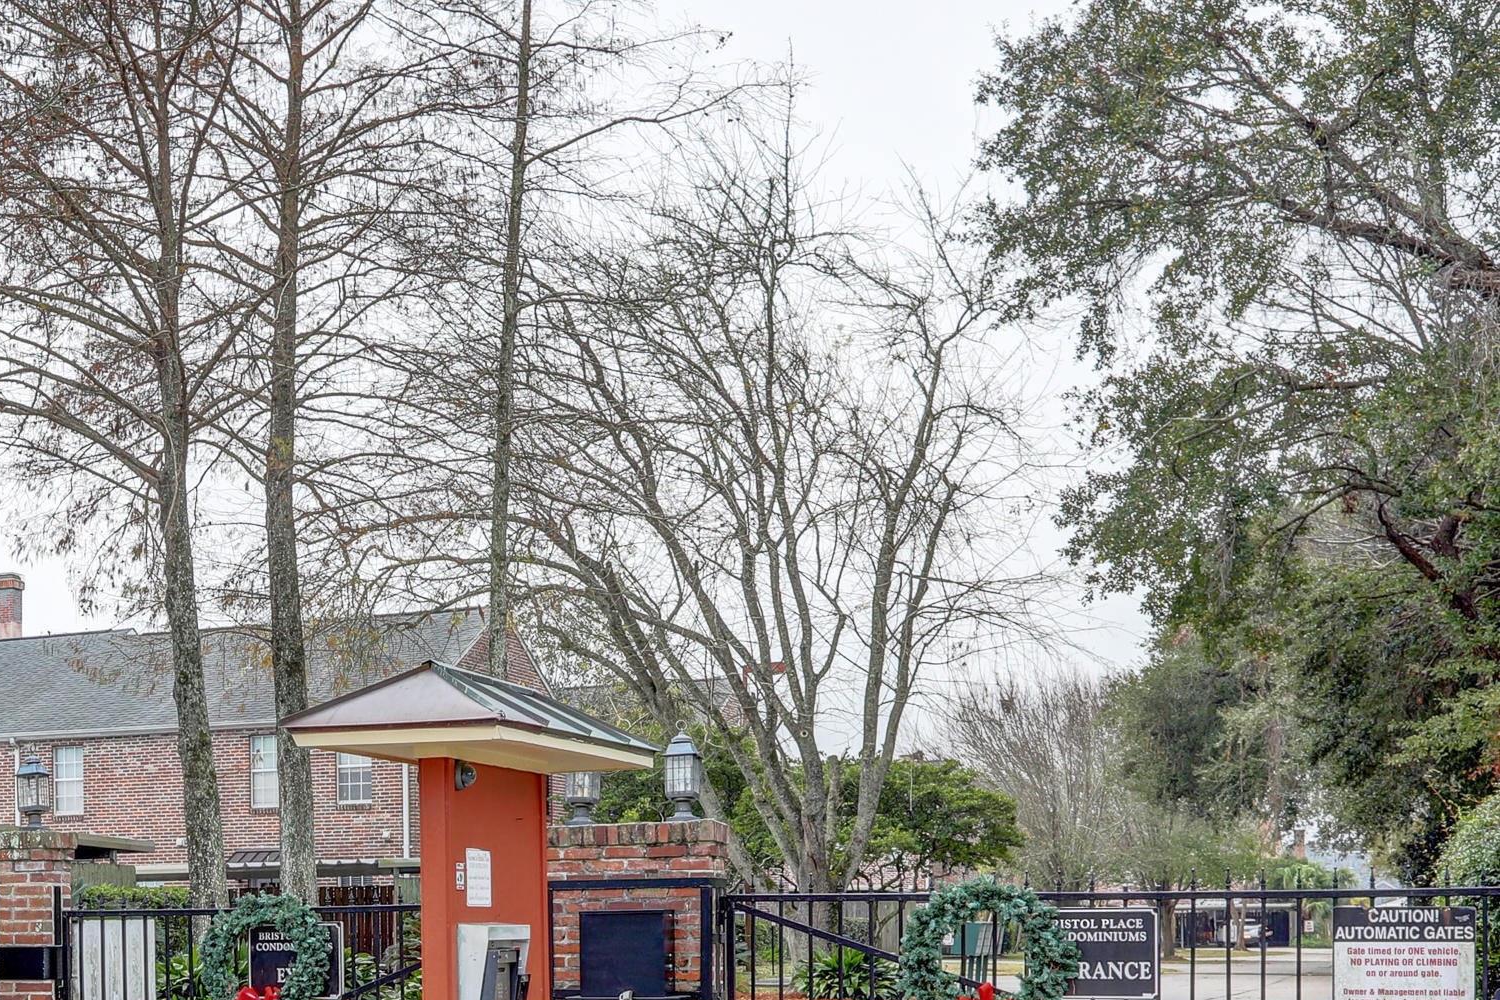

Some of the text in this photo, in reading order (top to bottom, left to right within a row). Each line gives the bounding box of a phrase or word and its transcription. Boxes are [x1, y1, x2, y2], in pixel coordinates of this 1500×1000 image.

[1368, 909, 1439, 923] CAUTION!
[1052, 918, 1144, 929] RISTOL PLACE
[1068, 931, 1147, 942] DOMINIUMS
[1335, 926, 1474, 940] AUTOMATIC GATES
[1347, 947, 1365, 955] Gate
[1368, 947, 1391, 955] timed
[1394, 947, 1406, 955] for
[1408, 947, 1425, 955] ONE
[1350, 958, 1458, 966] NO PLAYING OR CLIMBING
[1077, 962, 1152, 980] RANCE
[1389, 969, 1418, 977] around
[1421, 970, 1442, 978] gate.
[1343, 988, 1367, 996] Owner
[1378, 988, 1427, 997] Management
[1429, 988, 1441, 996] not
[1443, 988, 1465, 997] liable
